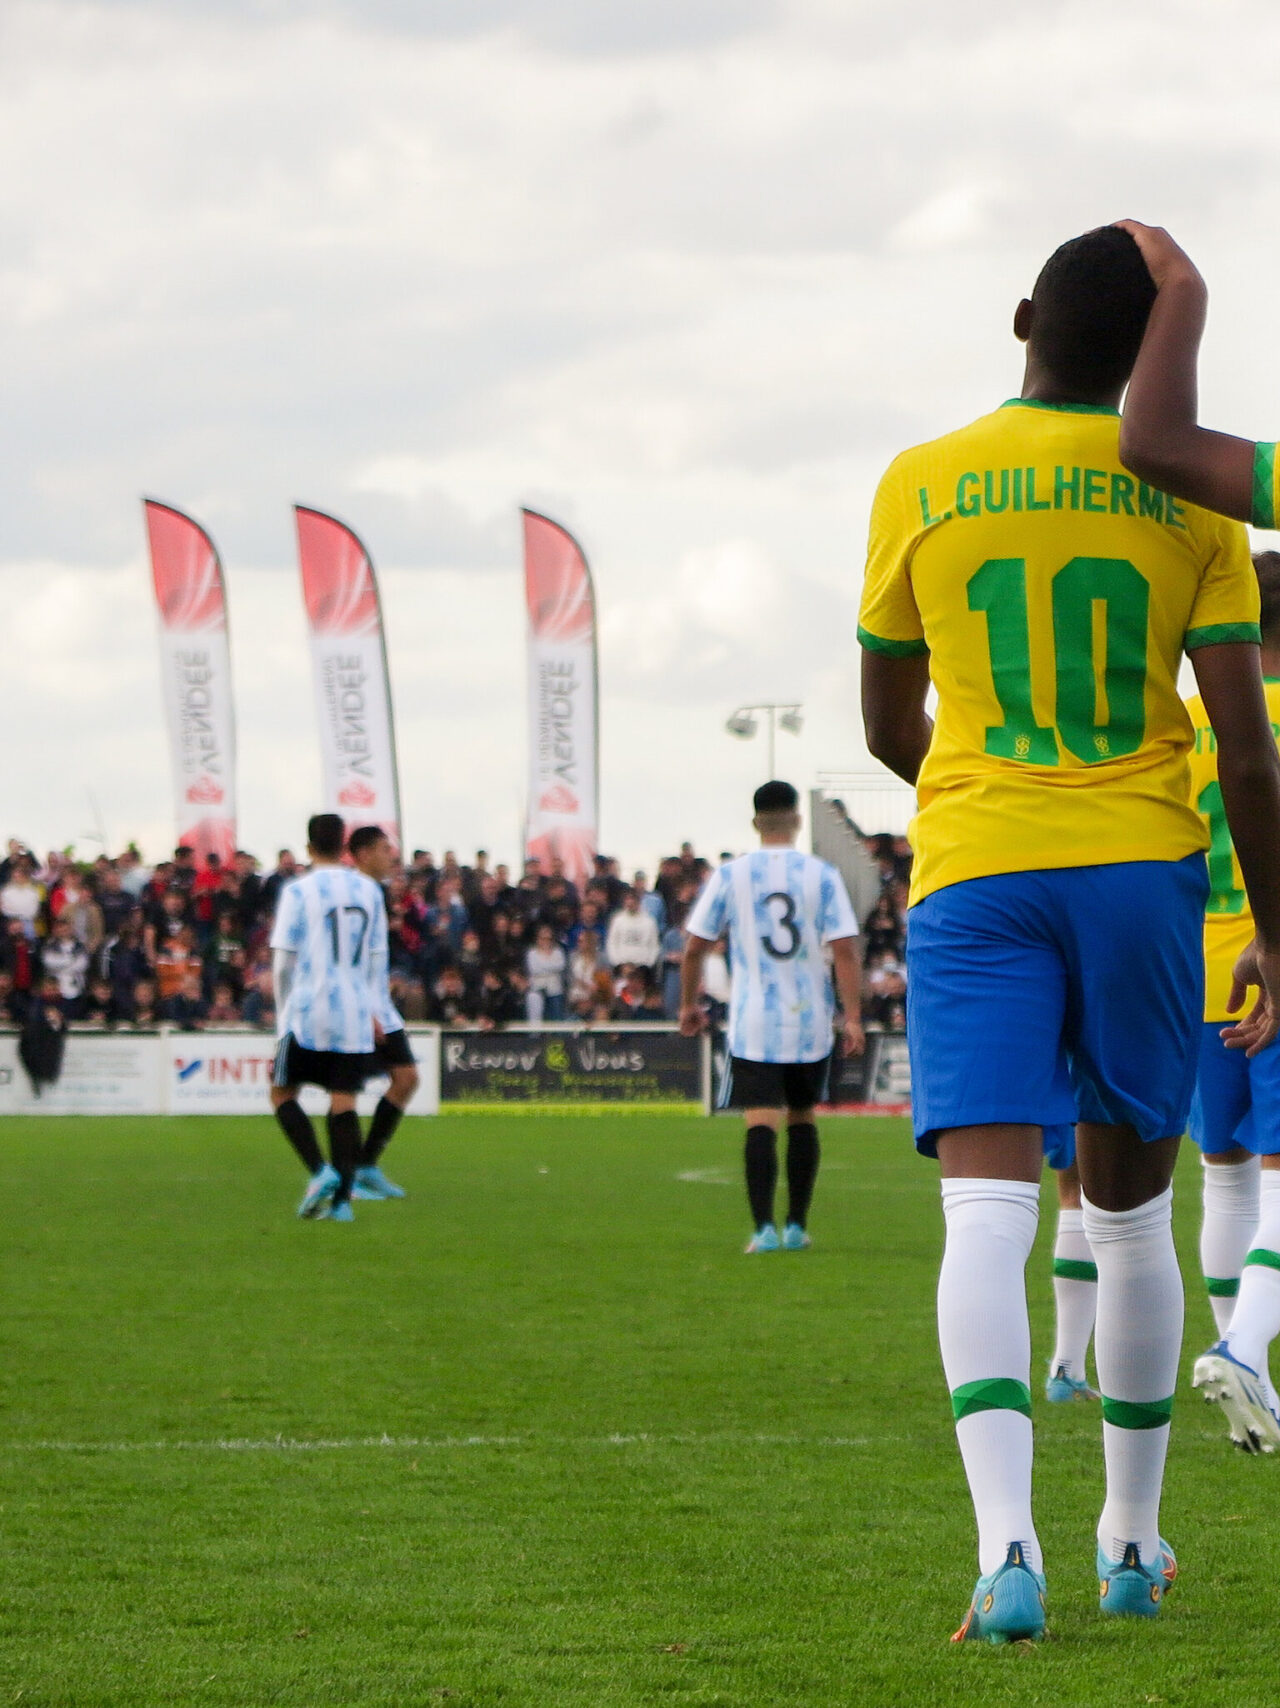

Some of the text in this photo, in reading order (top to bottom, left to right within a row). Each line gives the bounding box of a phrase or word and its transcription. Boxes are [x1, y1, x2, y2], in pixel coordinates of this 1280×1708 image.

[918, 465, 1188, 530] L.GUILHERME
[966, 556, 1150, 766] 10
[325, 906, 369, 966] 17
[761, 891, 800, 960] 3
